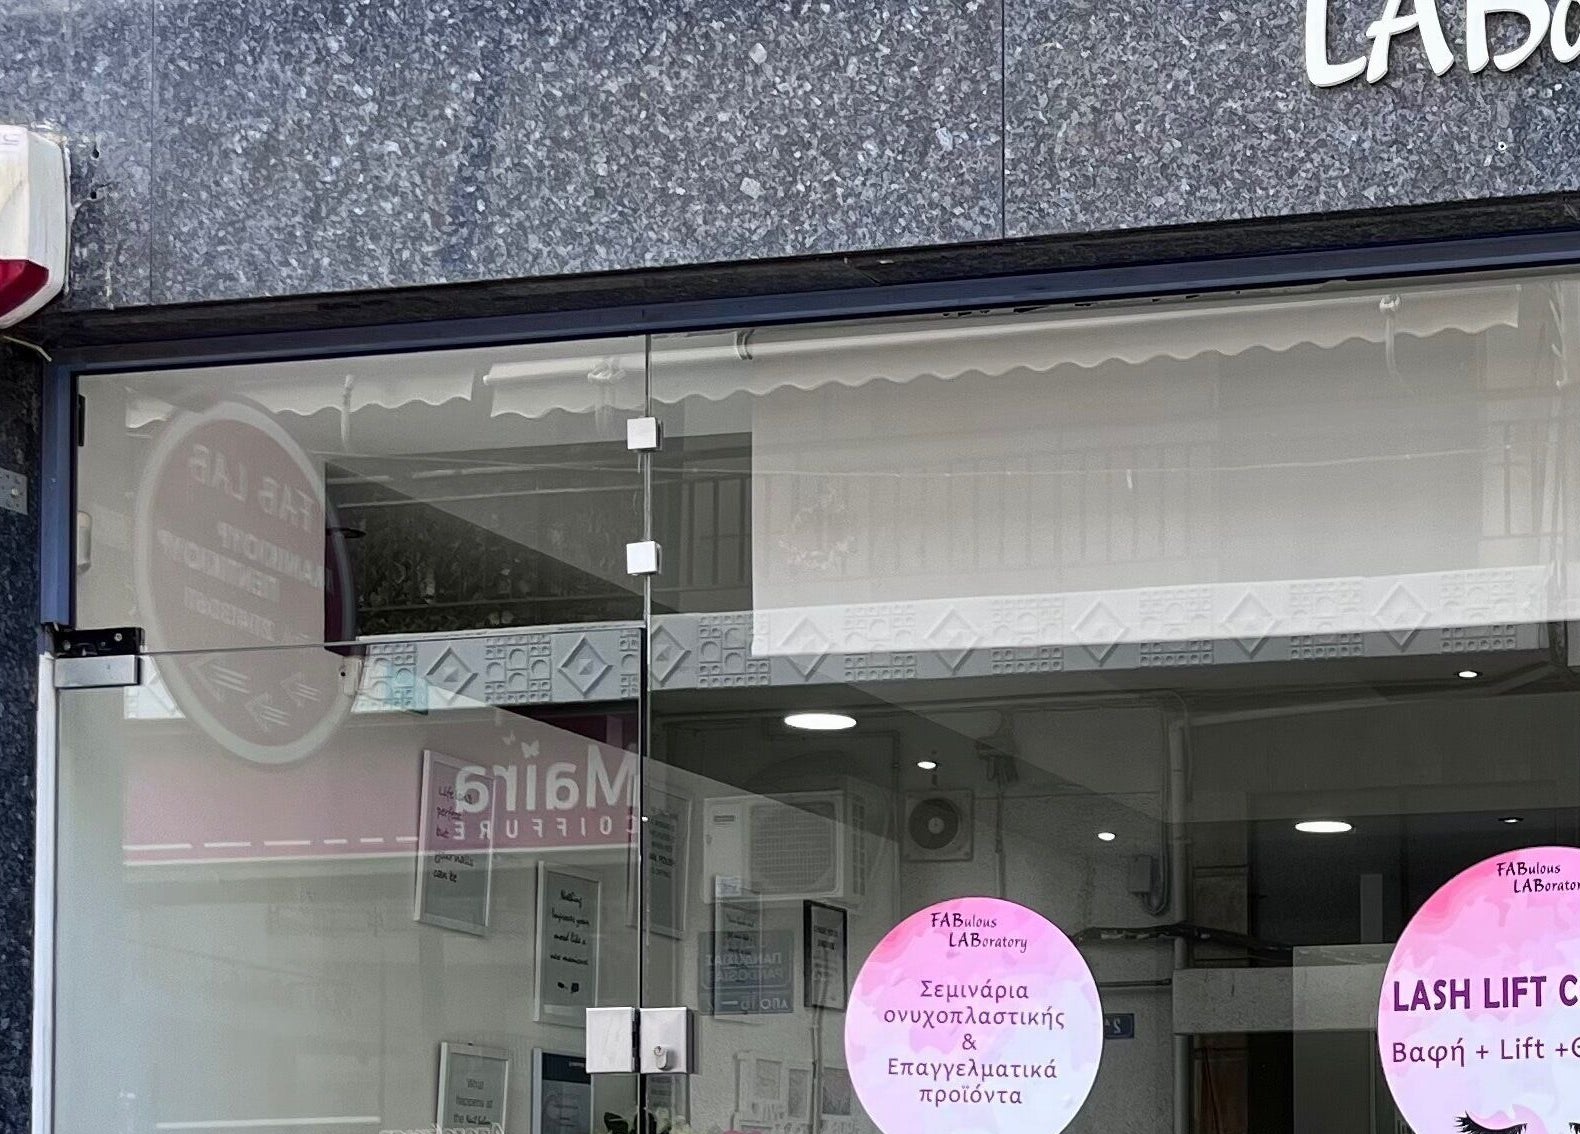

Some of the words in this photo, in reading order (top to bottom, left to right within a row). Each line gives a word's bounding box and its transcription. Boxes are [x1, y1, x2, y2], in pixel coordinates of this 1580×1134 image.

[1496, 861, 1561, 877] FABulous
[930, 912, 997, 928] FABulous
[949, 932, 1027, 953] LABoratory
[919, 979, 1029, 1003] Σεμινάρια
[1393, 979, 1471, 1011] LASH
[1483, 975, 1547, 1009] LIFT
[883, 1006, 1065, 1030] ονυχοπλαστικής
[961, 1033, 977, 1050] &
[1392, 1038, 1466, 1068] Βαφή
[1500, 1037, 1545, 1060] Lift
[888, 1058, 1057, 1081] Επαγγελματικά
[919, 1084, 1022, 1108] προϊόντα
